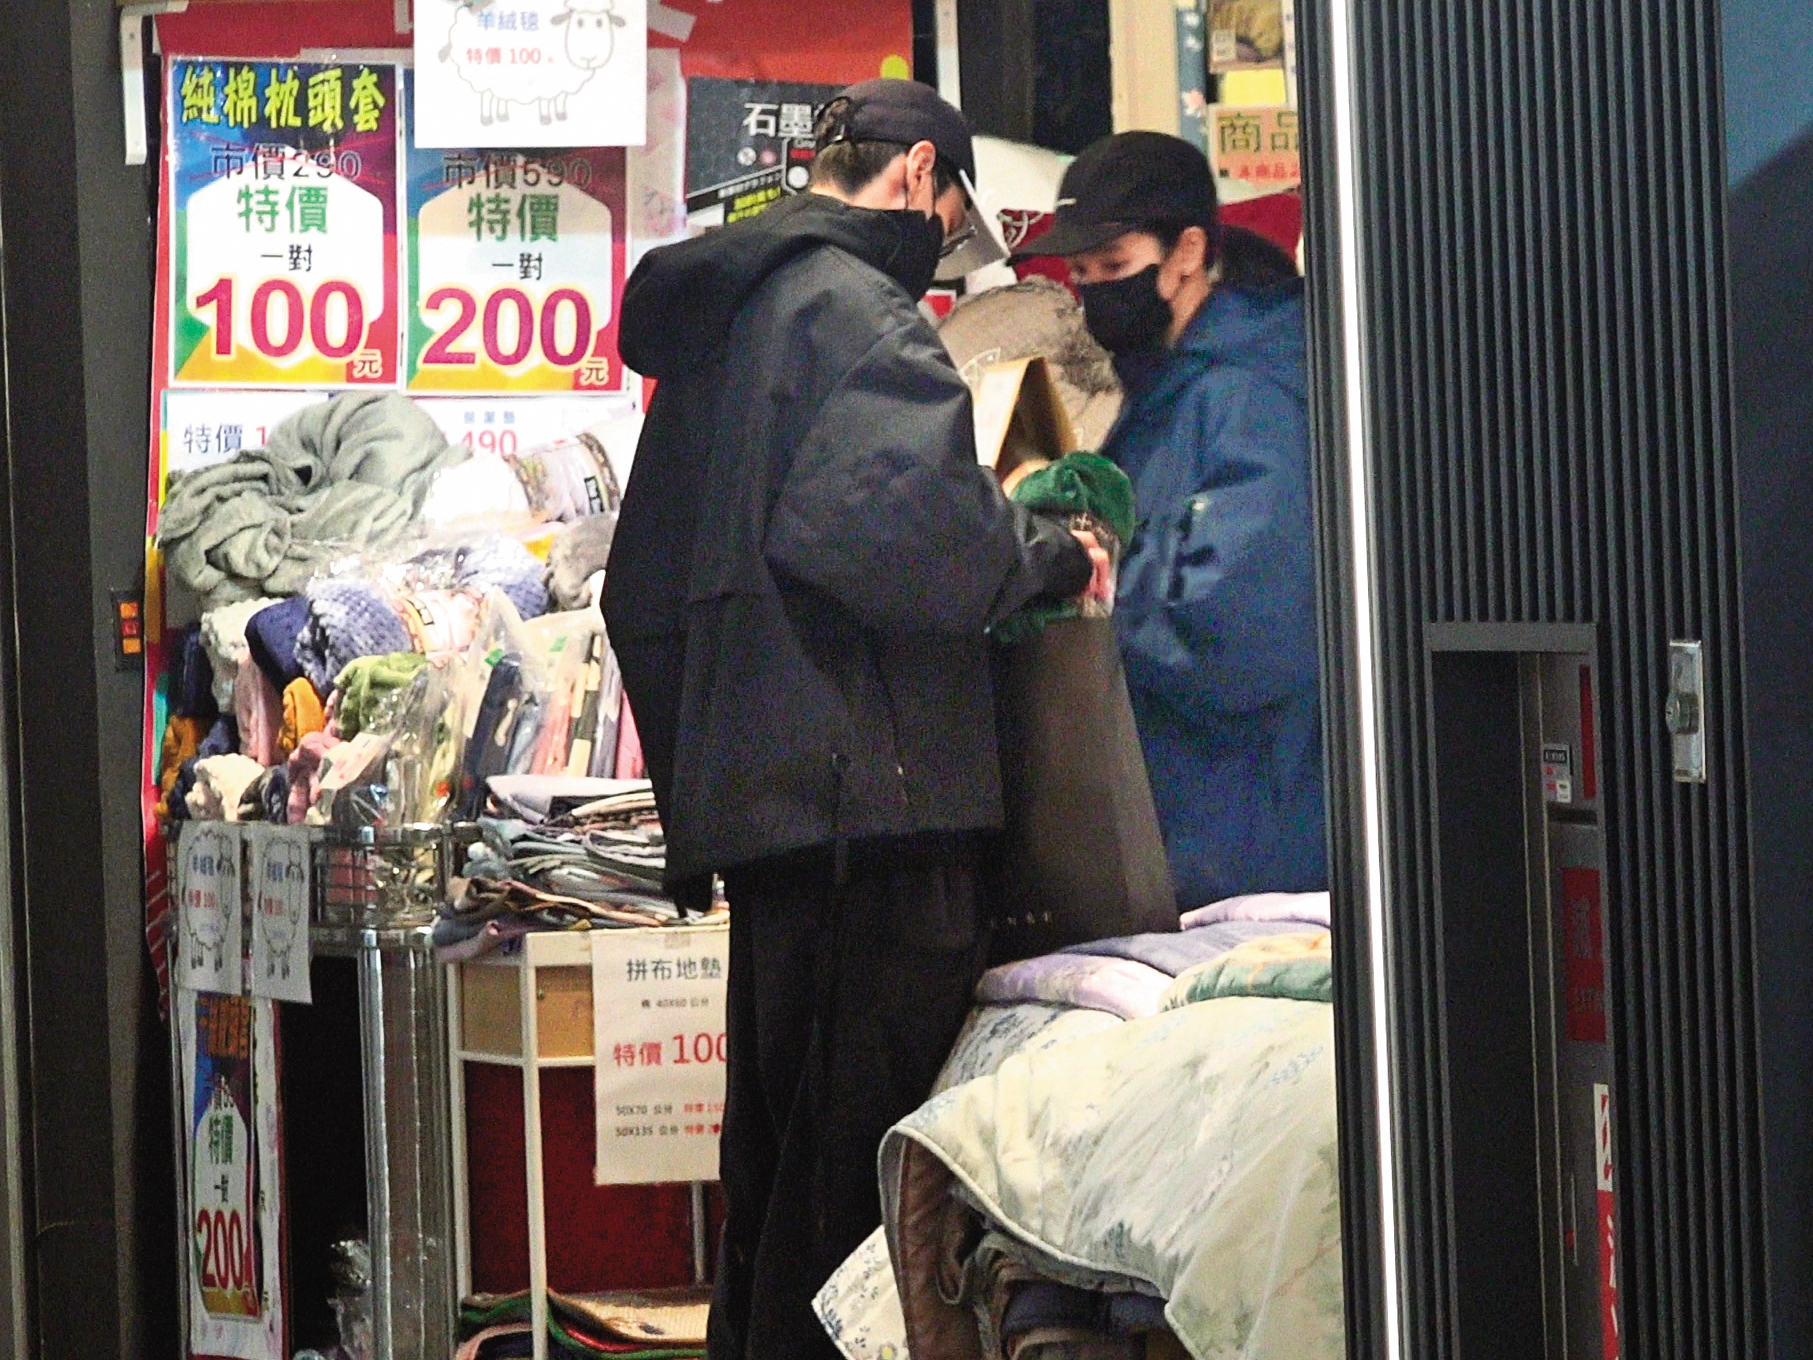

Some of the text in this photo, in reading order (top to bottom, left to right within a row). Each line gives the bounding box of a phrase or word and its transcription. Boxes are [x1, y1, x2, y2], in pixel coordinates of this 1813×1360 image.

[465, 47, 542, 66] 特價 100
[180, 64, 386, 133] 純棉枕頭套
[742, 103, 824, 138] 石墨
[210, 142, 362, 182] 市價290
[443, 152, 593, 191] 市價590
[236, 184, 328, 234] 特價
[467, 192, 561, 242] 特價
[260, 243, 313, 272] 一對
[491, 252, 543, 281] 一對
[195, 278, 380, 374] 100 元
[422, 287, 605, 382] 200 元
[183, 424, 244, 454] 特價
[626, 957, 723, 982] 拼布地墊
[613, 1032, 728, 1067] 特價 100
[209, 1114, 233, 1165] 特價
[197, 1208, 245, 1290] 200
